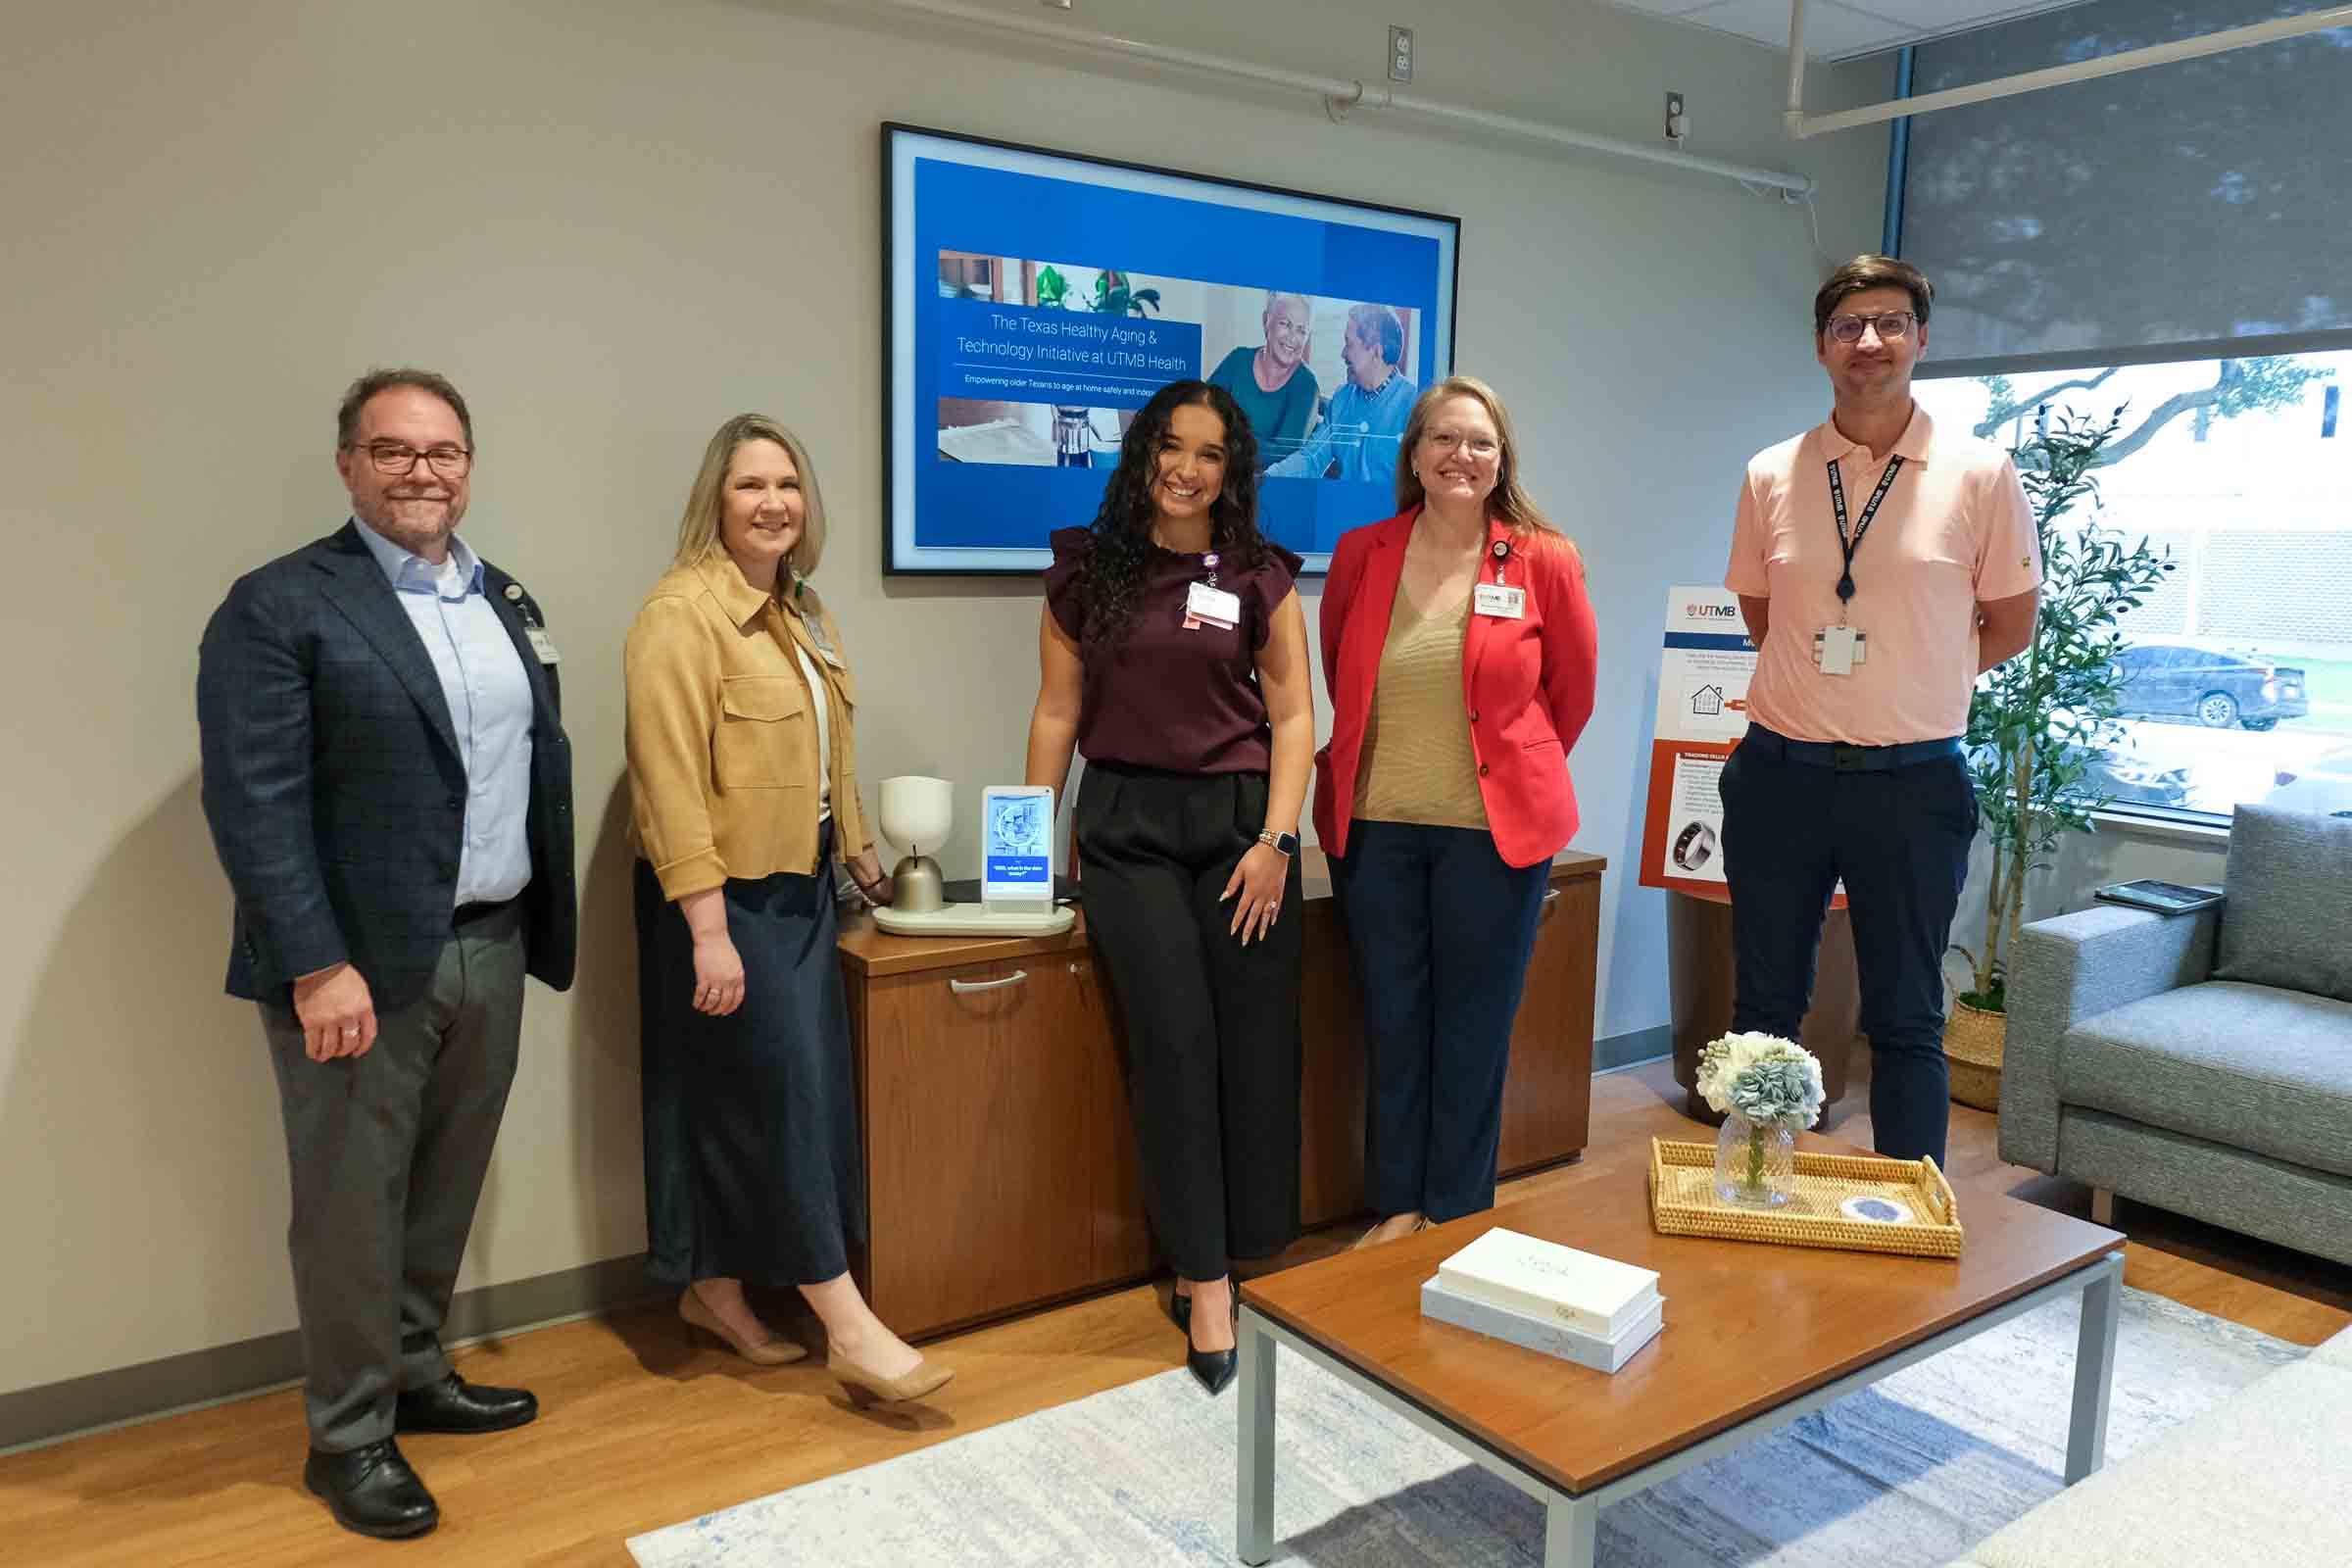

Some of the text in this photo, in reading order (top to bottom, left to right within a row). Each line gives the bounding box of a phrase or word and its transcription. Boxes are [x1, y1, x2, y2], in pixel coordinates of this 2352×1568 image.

[991, 314, 1157, 346] The Texas Healthy Aging &
[956, 336, 1186, 371] Technology Initiative at UTMB Health
[964, 373, 1008, 388] Empowering
[1009, 376, 1027, 387] older
[1029, 379, 1053, 389] Texans
[1053, 381, 1060, 390] to
[1061, 383, 1075, 392] age
[1083, 383, 1102, 392] home
[1699, 605, 1737, 617] UTMB
